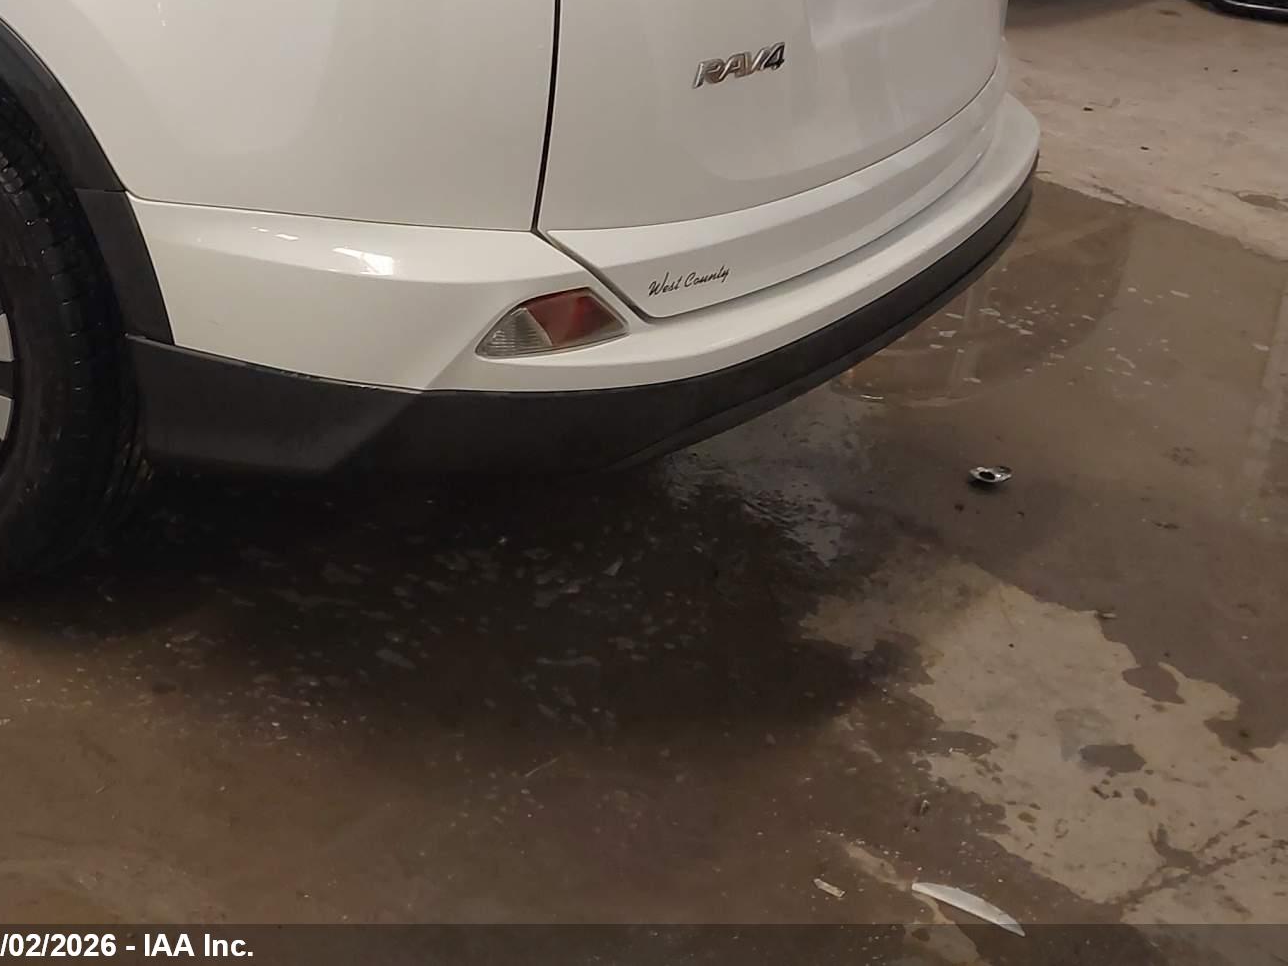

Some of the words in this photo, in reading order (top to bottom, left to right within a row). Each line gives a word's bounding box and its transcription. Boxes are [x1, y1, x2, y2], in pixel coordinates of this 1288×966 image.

[692, 41, 785, 89] RAV4
[648, 271, 683, 296] West
[684, 264, 730, 287] County
